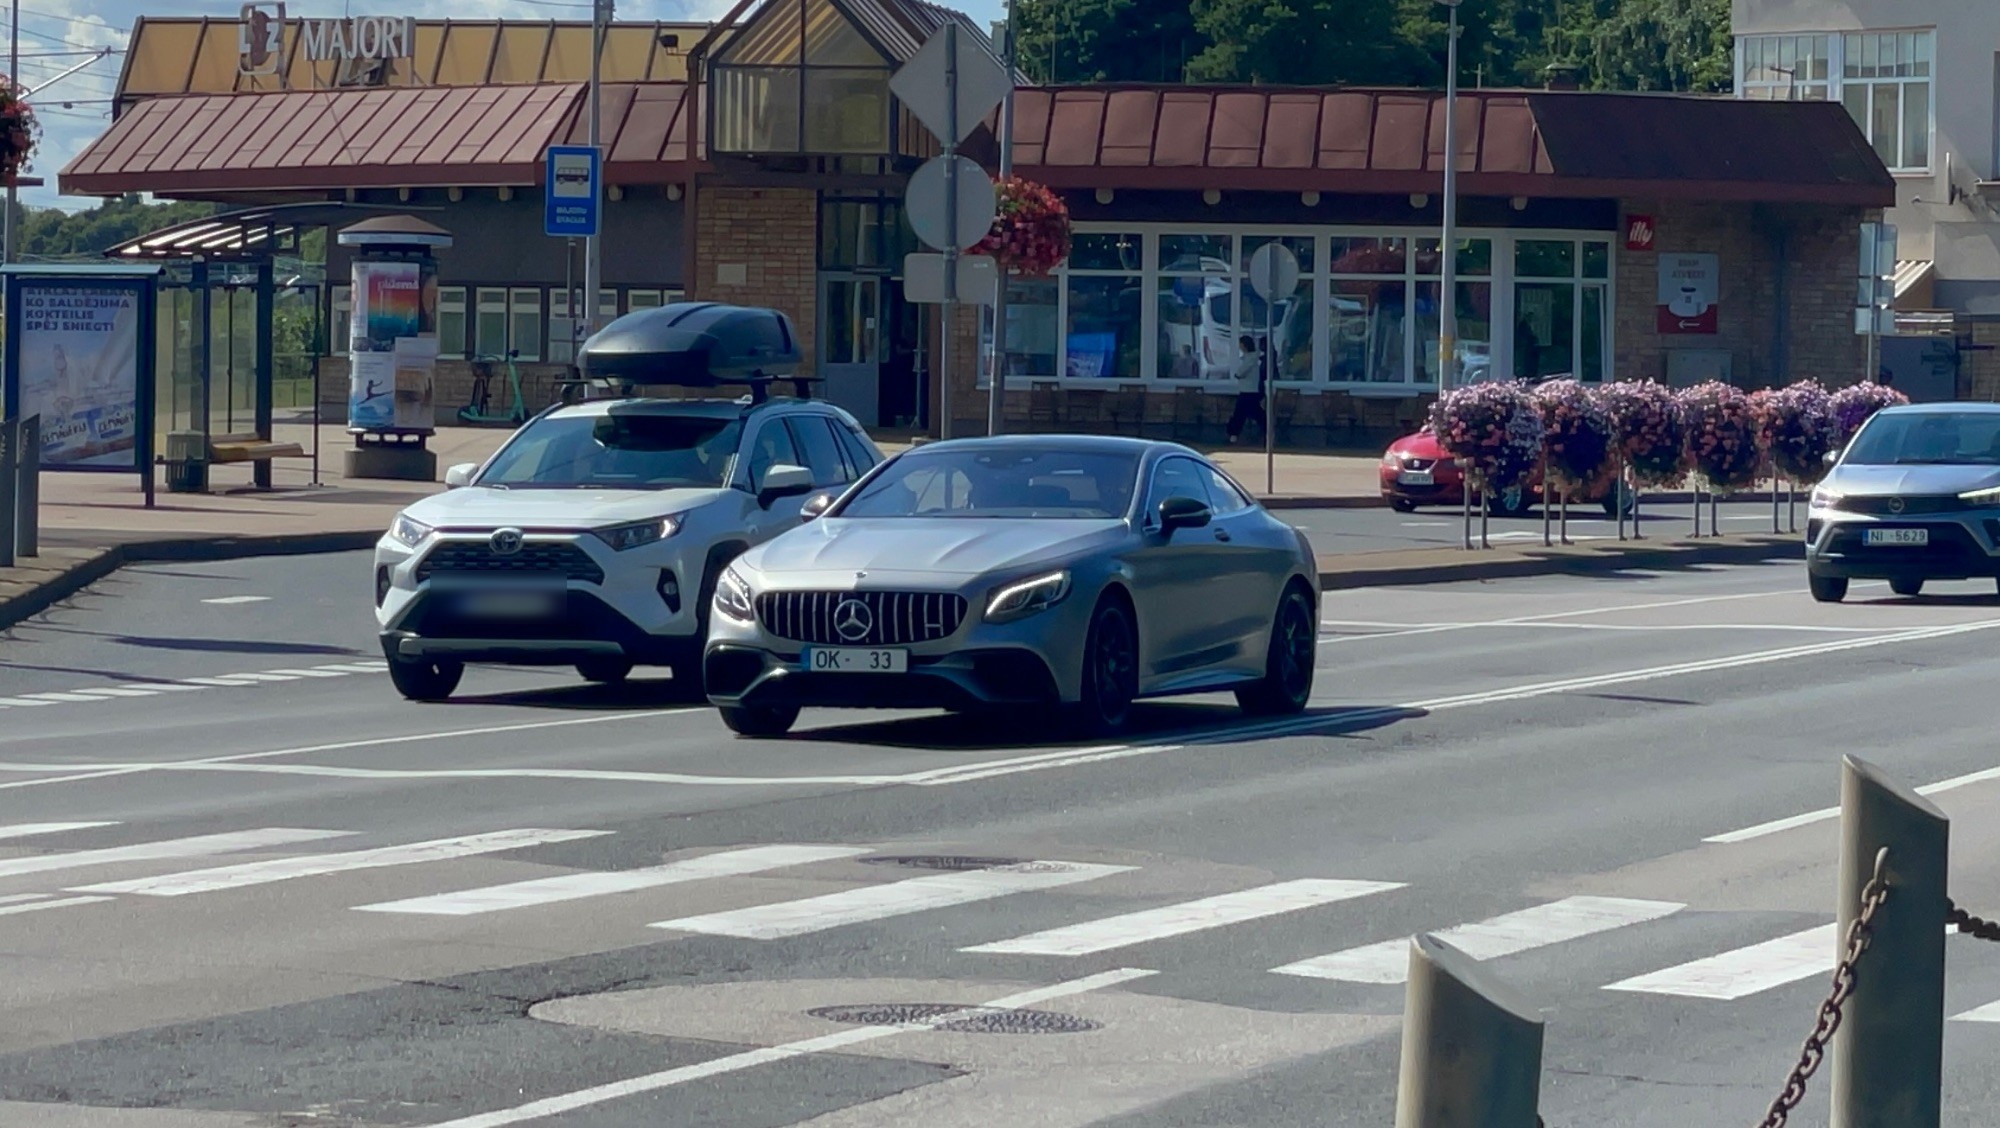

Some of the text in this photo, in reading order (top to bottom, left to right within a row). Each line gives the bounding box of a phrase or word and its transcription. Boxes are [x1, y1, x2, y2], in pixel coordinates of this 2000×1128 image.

[303, 17, 409, 61] MAJORI
[1628, 220, 1653, 246] illy
[25, 298, 44, 307] KO
